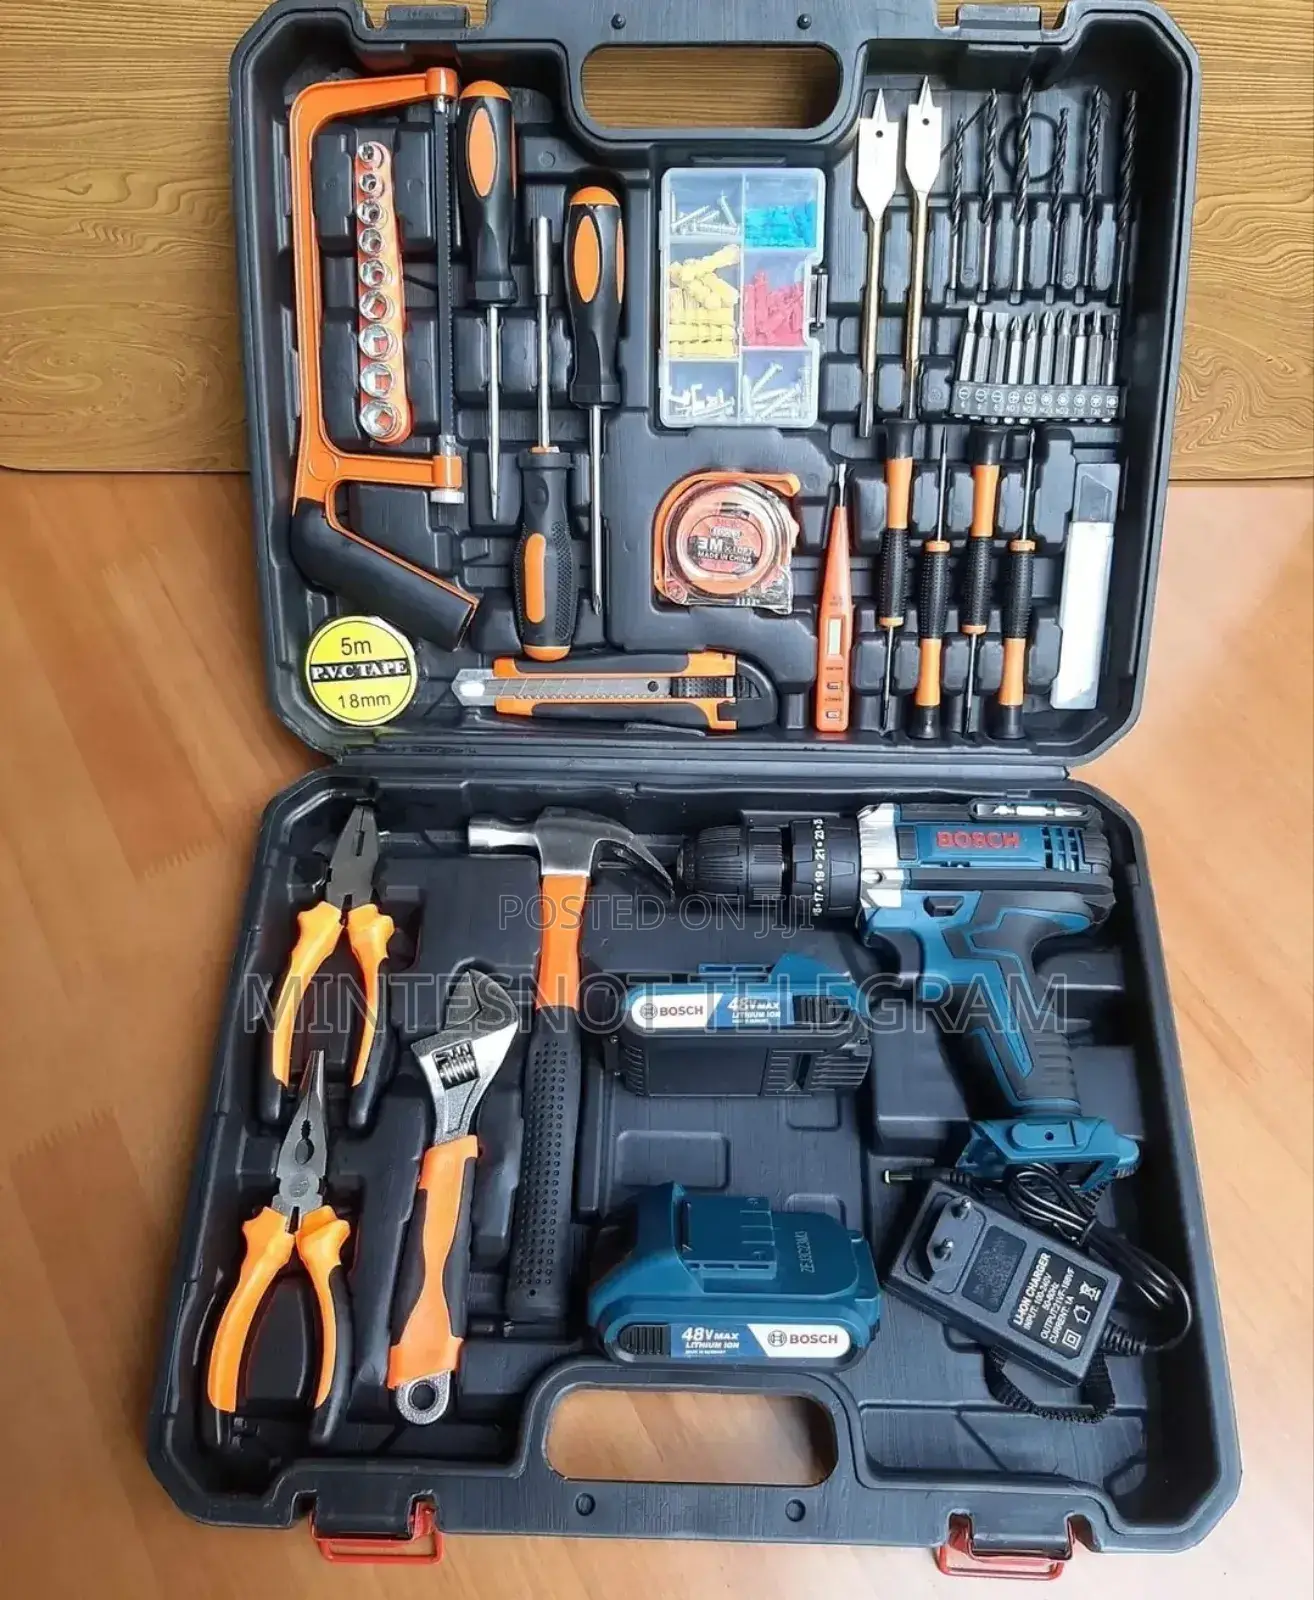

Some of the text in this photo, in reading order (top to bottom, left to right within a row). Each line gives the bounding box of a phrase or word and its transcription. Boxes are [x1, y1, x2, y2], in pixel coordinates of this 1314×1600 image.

[697, 550, 718, 559] MADE
[729, 554, 752, 563] CHINA
[341, 637, 372, 656] 5m
[312, 661, 407, 680] P.V.C TAPE
[338, 693, 391, 709] 18mm
[937, 830, 1019, 849] BOSCH
[815, 848, 825, 860] 21
[815, 870, 825, 883] 19
[814, 892, 824, 902] 17
[659, 1005, 704, 1017] BOSCH
[732, 1010, 781, 1019] LITHIUM ION
[1024, 1252, 1051, 1298] CHARGER
[1065, 1294, 1075, 1307] 1A
[681, 1327, 714, 1342] 48V
[790, 1334, 838, 1344] BOSCH
[685, 1341, 740, 1349] LITHIUM ION
